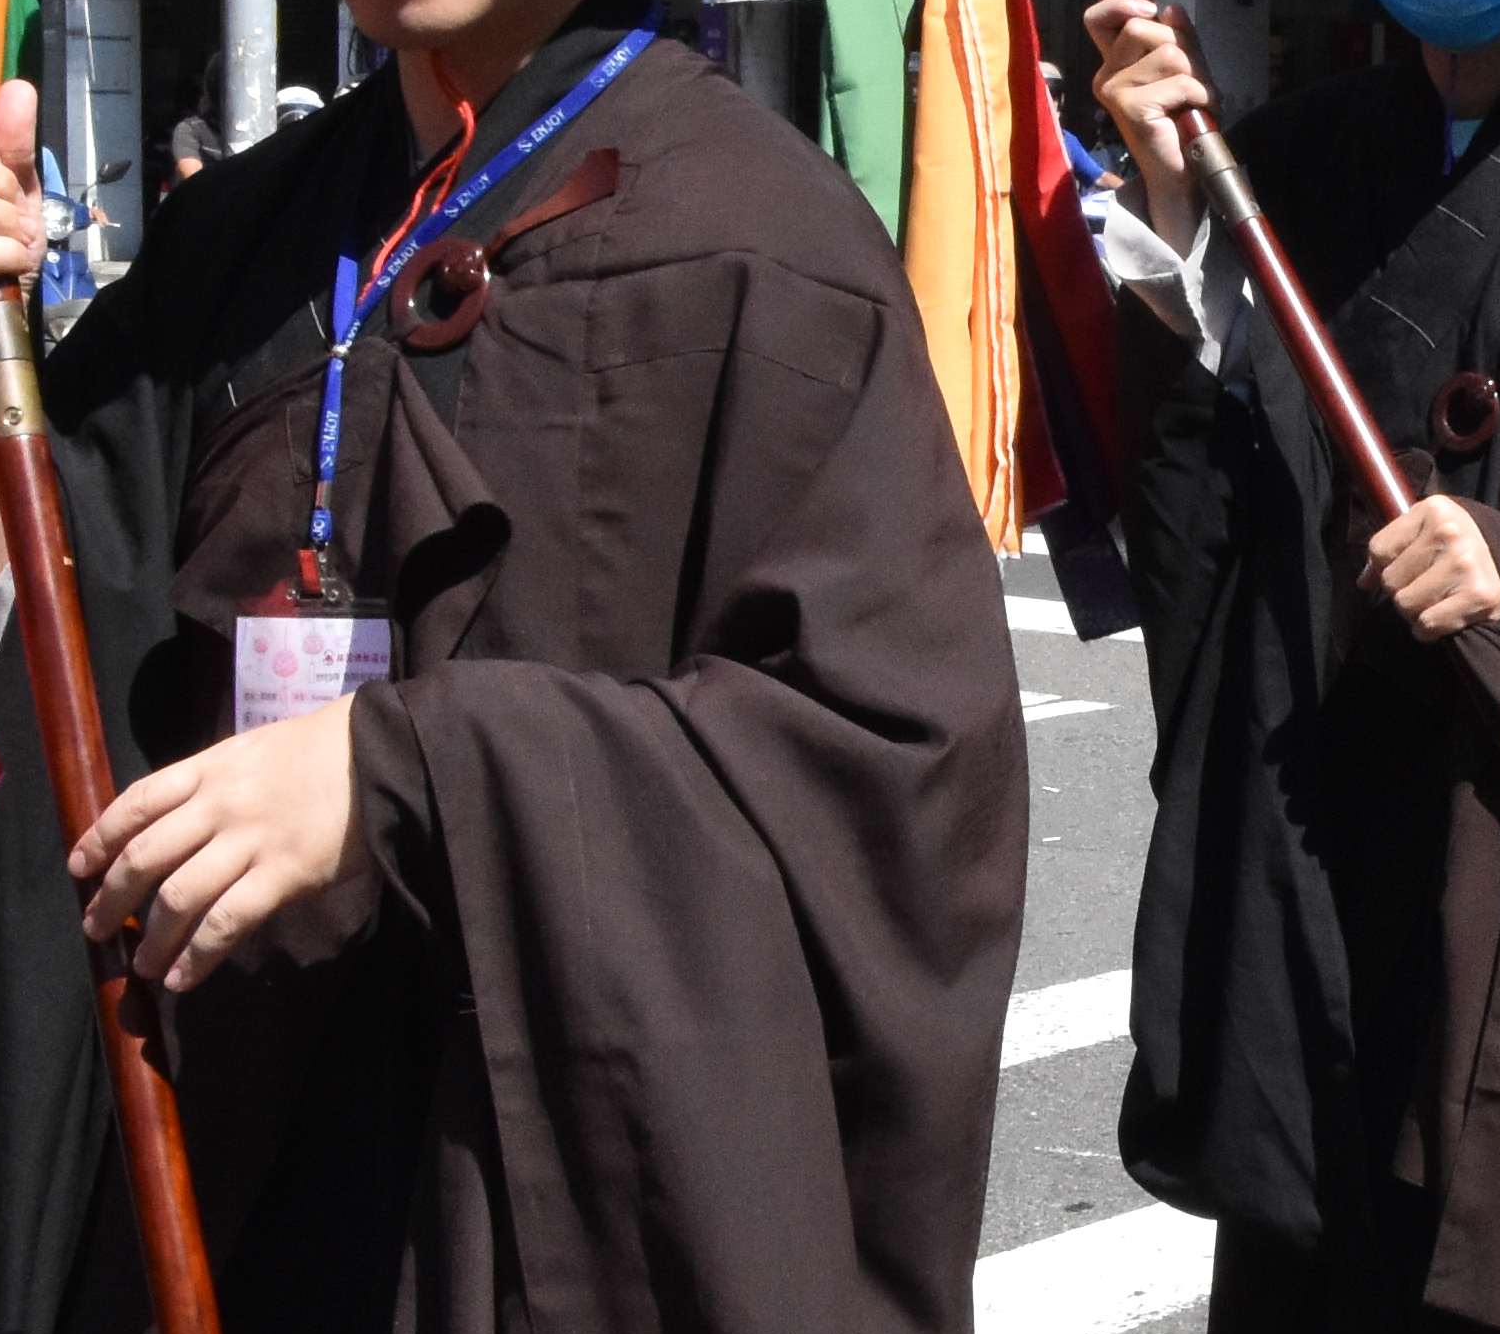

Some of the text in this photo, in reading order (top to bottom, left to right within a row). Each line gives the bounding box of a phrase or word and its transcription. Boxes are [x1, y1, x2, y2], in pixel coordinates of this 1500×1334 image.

[602, 45, 635, 77] ENJOY
[531, 108, 566, 143] ENJOY
[456, 173, 491, 208] ENJOY
[387, 239, 422, 277] ENJOY
[321, 410, 341, 457] ENJOY
